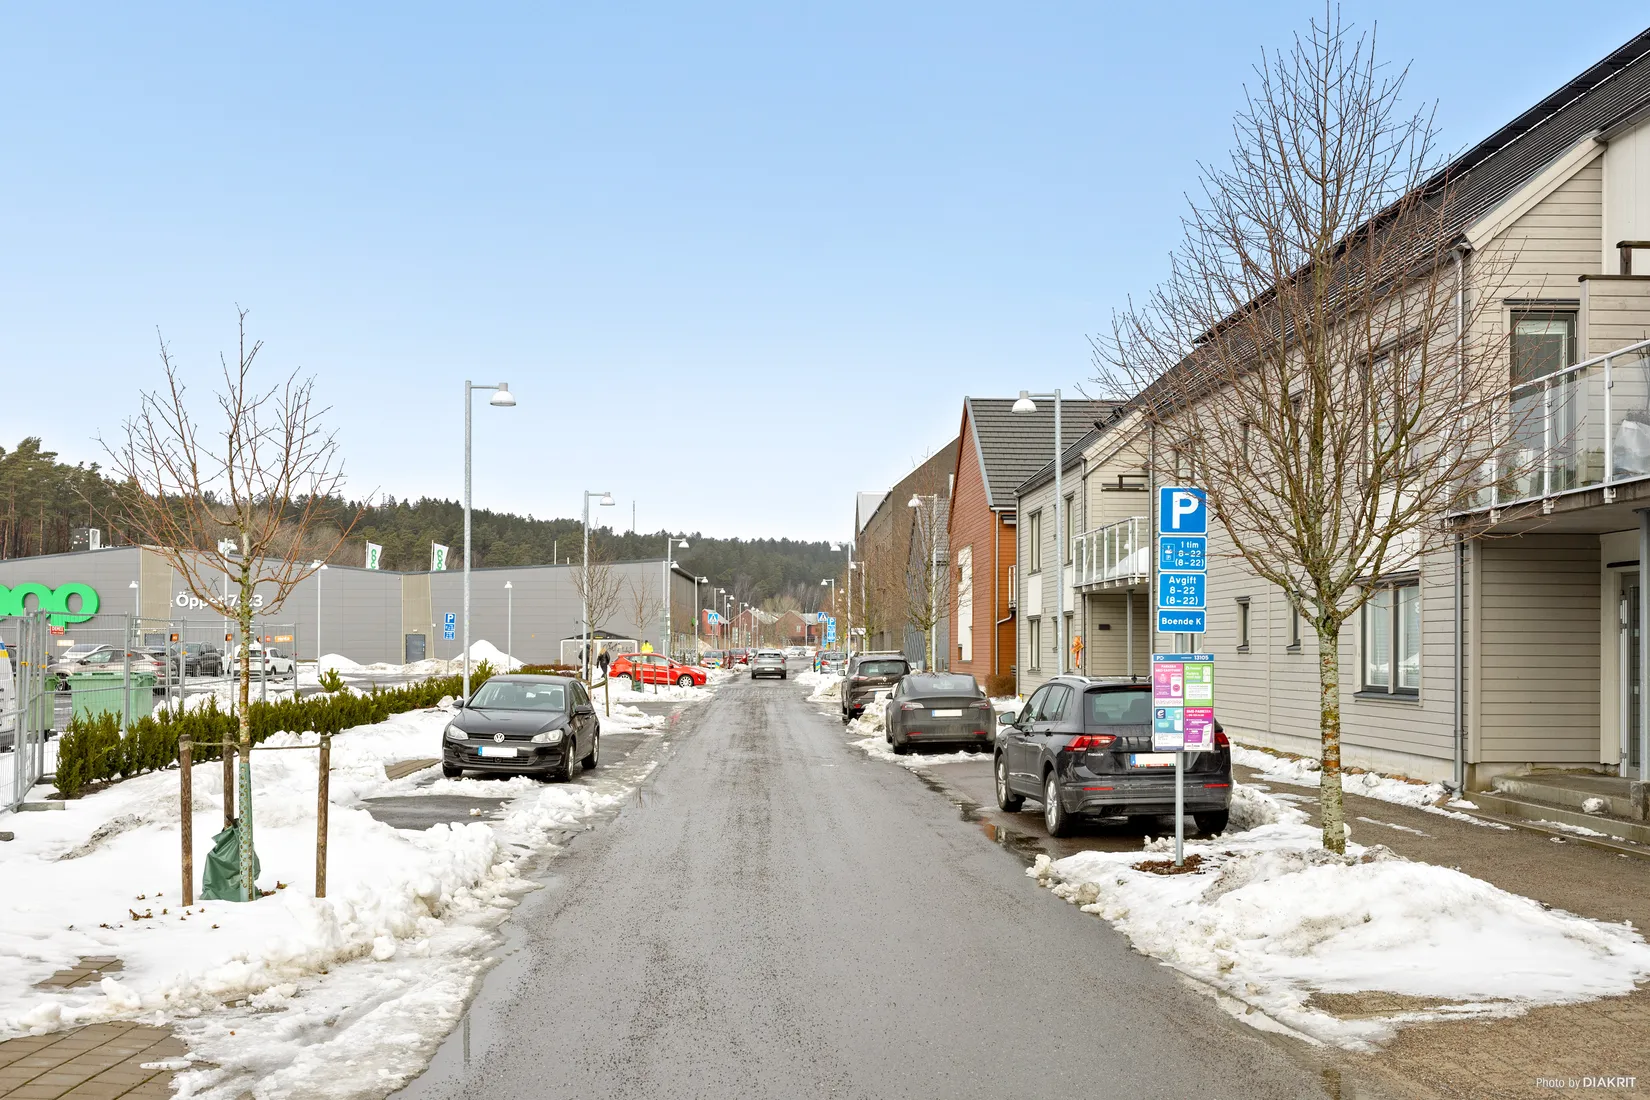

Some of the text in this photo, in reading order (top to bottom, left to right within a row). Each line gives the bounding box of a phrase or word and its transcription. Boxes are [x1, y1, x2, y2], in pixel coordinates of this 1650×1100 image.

[1172, 491, 1199, 529] P
[1169, 576, 1197, 585] Avgift
[1169, 586, 1195, 594] 8-22
[1166, 595, 1199, 605] (8-22)
[1161, 617, 1202, 625] Boende K
